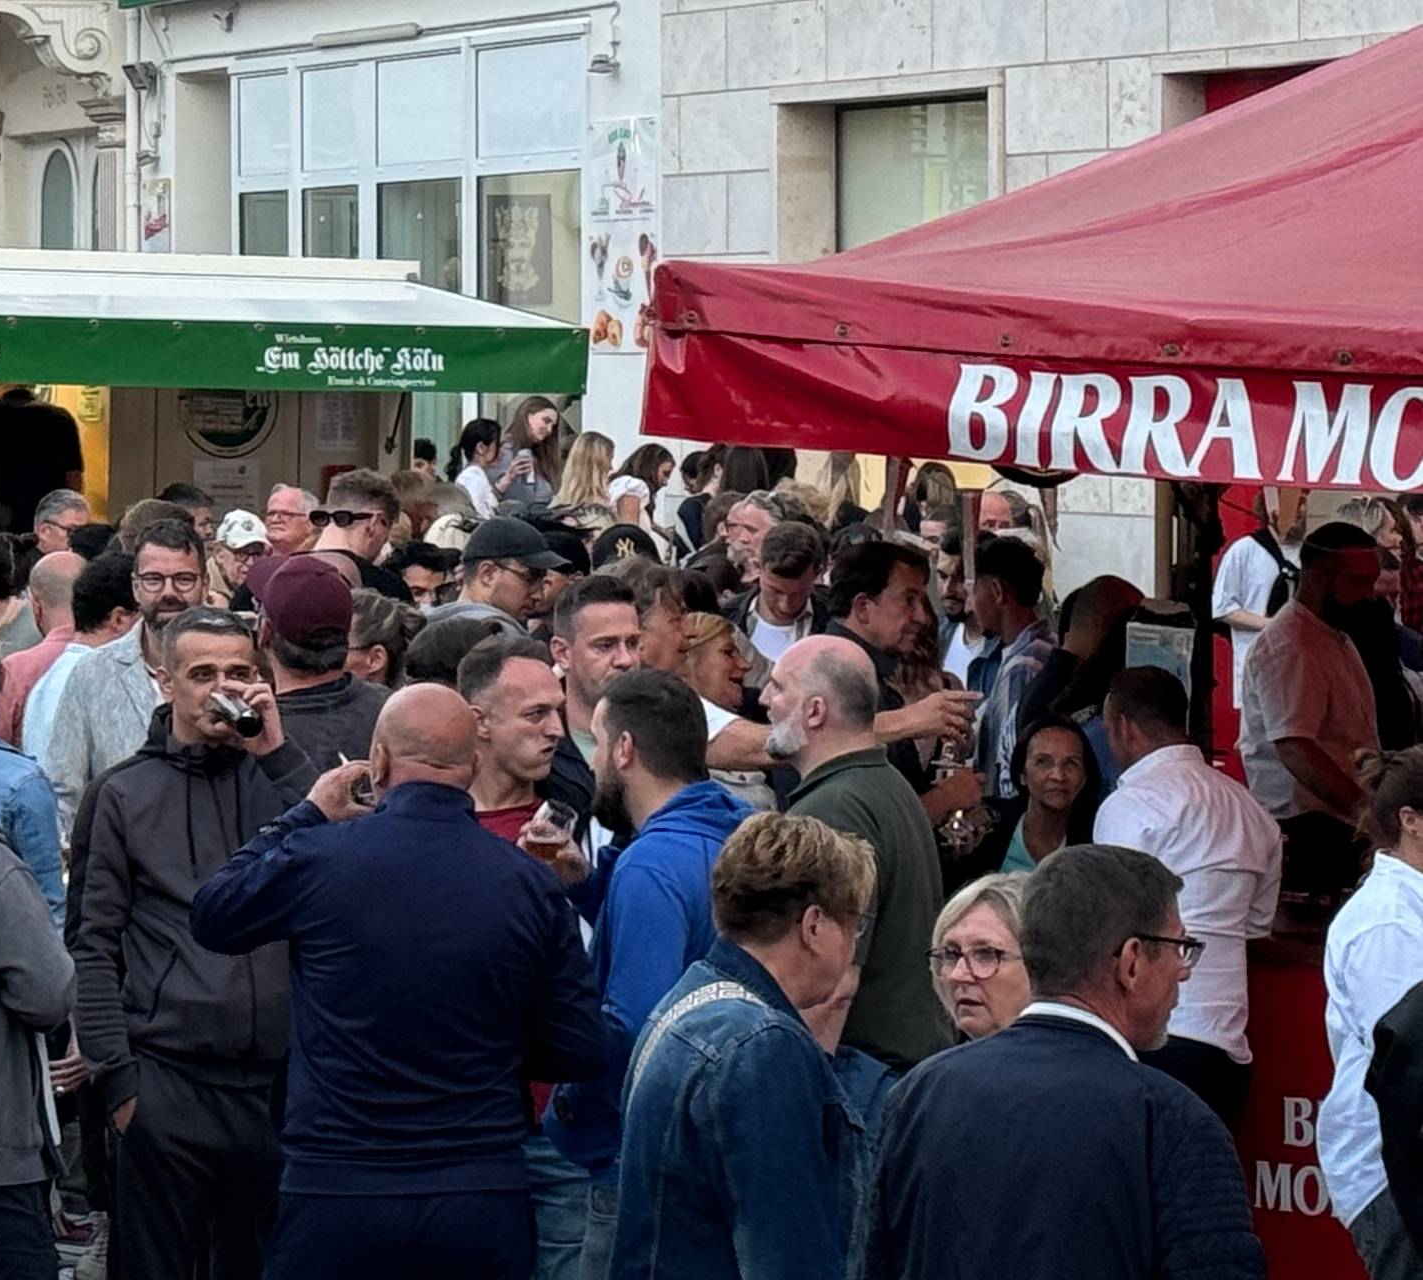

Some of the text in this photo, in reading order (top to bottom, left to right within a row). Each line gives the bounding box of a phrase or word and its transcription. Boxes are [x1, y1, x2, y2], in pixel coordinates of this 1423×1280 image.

[389, 347, 445, 376] Köln
[947, 362, 1264, 480] BIRRA
[616, 537, 636, 558] NY
[1283, 1096, 1325, 1147] B
